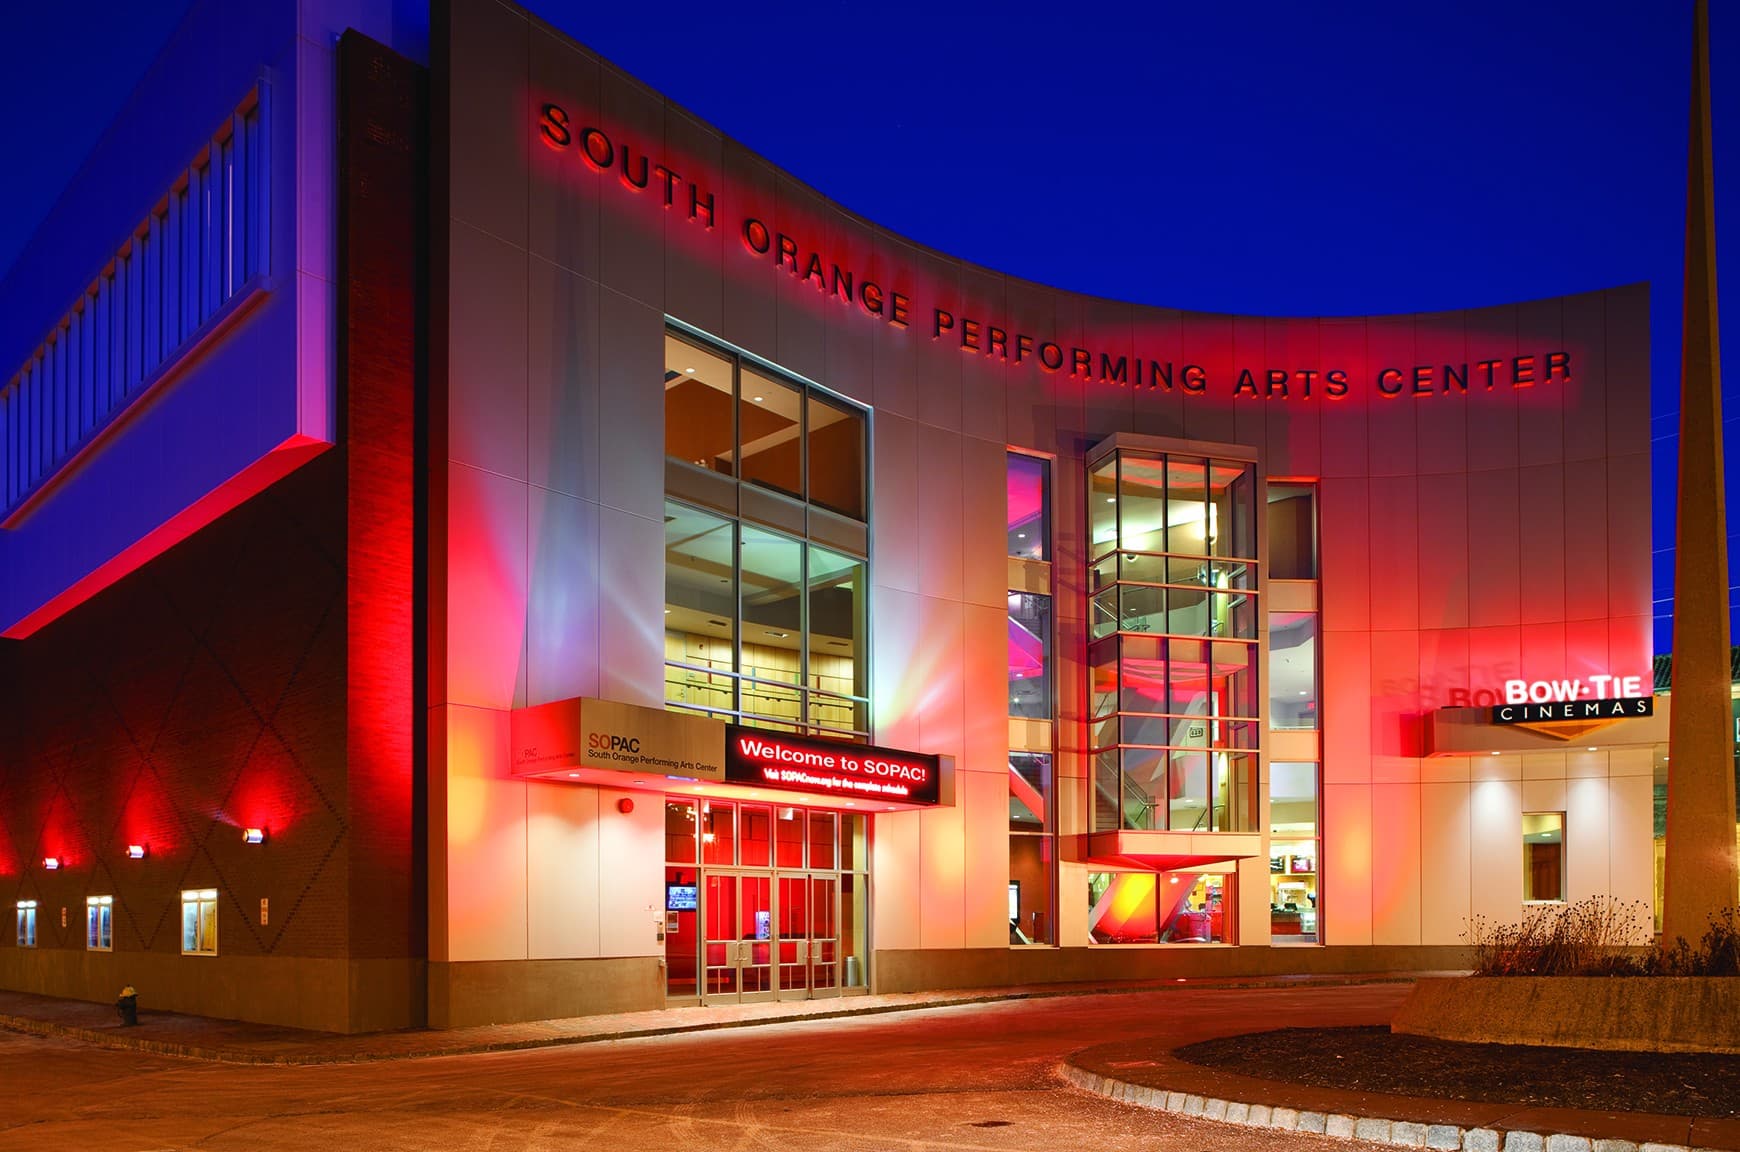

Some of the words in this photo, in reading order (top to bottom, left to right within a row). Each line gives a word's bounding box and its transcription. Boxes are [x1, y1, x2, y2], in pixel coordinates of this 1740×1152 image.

[541, 103, 715, 231] SOUTH
[743, 217, 910, 329] ORANGE
[932, 308, 1208, 395] PERFORMING
[1233, 367, 1349, 399] ARTS
[1376, 350, 1572, 398] CENTER
[1500, 701, 1647, 721] CINEMAS
[588, 732, 640, 754] SOPAC
[588, 749, 611, 760] South
[612, 752, 640, 765] Orange
[640, 755, 679, 770] Performing
[680, 760, 694, 770] Arts
[695, 762, 718, 773] Center
[740, 738, 835, 768] Welcome
[839, 756, 858, 771] to
[863, 759, 926, 782] SOPAC!
